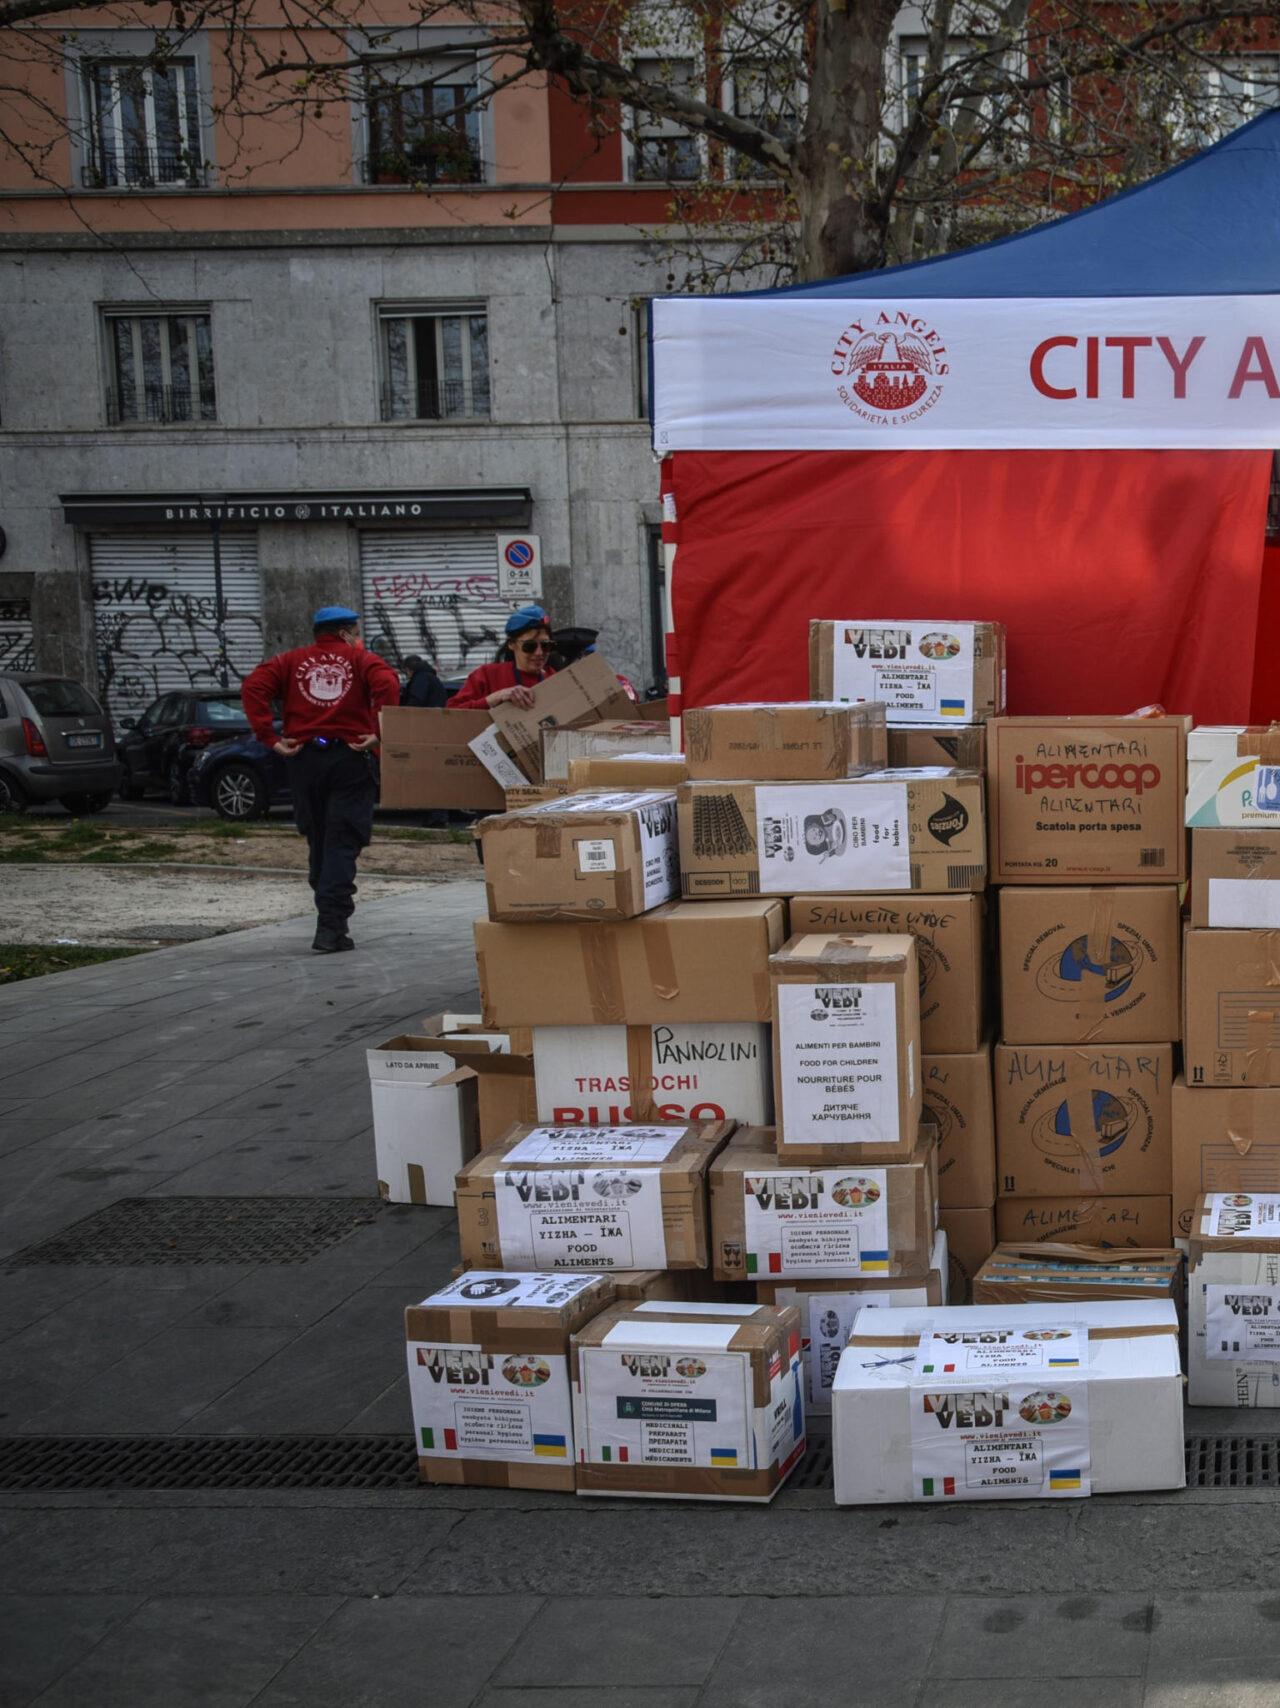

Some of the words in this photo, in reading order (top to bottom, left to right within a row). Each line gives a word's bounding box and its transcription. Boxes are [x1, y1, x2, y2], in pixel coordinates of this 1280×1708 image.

[831, 318, 865, 376] CITY
[876, 311, 950, 378] ANGELS
[1030, 336, 1206, 400] CITY
[900, 383, 945, 425] SICUREZZA
[165, 507, 286, 519] BIRRIFICIO
[321, 504, 423, 517] ITALIANO
[854, 643, 908, 659] VEDI
[296, 656, 316, 679] CITY
[320, 653, 353, 679] ANGELS
[1037, 737, 1148, 759] ALIMENTARI
[1016, 755, 1161, 795] ipercoop
[1040, 796, 1142, 815] ALIMENTARI
[646, 816, 672, 838] VEDI
[872, 824, 880, 844] food
[892, 819, 900, 847] babies
[1036, 821, 1075, 831] Scatola
[1079, 822, 1107, 833] porta
[1111, 823, 1141, 833] spesa
[852, 833, 860, 849] CIBO
[1045, 858, 1058, 867] 20
[1023, 943, 1038, 972] SPECIAL
[1036, 923, 1066, 943] REMOVAL
[822, 998, 859, 1008] VEDI
[654, 1026, 758, 1064] PANNOLINI
[795, 1042, 831, 1050] ALIMENTI
[849, 1041, 881, 1049] BAMBINI
[800, 1059, 821, 1067] FOOD
[840, 1058, 878, 1066] CHILDREN
[575, 1075, 699, 1093] TRASOCHI
[797, 1075, 855, 1084] NOURRITURE
[857, 1074, 882, 1082] POUR
[822, 1103, 859, 1112] ДИТЯЧЕ
[812, 1113, 871, 1121] ХАРЧУВАННЯ
[515, 1184, 580, 1202] VEDI
[745, 1177, 824, 1194] VIENI
[523, 1200, 627, 1209] www.vienievedi.it
[756, 1193, 819, 1210] VEDI
[542, 1215, 617, 1224] ALIMENTARI
[778, 1211, 863, 1219] www.vienievedi.it
[539, 1230, 577, 1239] YIZHA
[600, 1227, 623, 1237] ЇЖА
[568, 1244, 597, 1252] FOOD
[554, 1257, 614, 1267] ALIMENTS
[1231, 1305, 1268, 1316] VEDI
[417, 1348, 494, 1369] VIENI
[427, 1366, 489, 1385] VEDI
[629, 1364, 668, 1377] VEDI
[450, 1387, 536, 1397] www.vienievedi.it
[924, 1392, 1009, 1412] VIENI
[935, 1410, 1004, 1428] VEDI
[960, 1430, 1042, 1440] www.vienievedi.it
[974, 1442, 1033, 1452] ALIMENTARI
[971, 1456, 1001, 1464] YIZHA
[992, 1466, 1017, 1474] FOOD
[980, 1477, 1029, 1486] ALIMENTS
